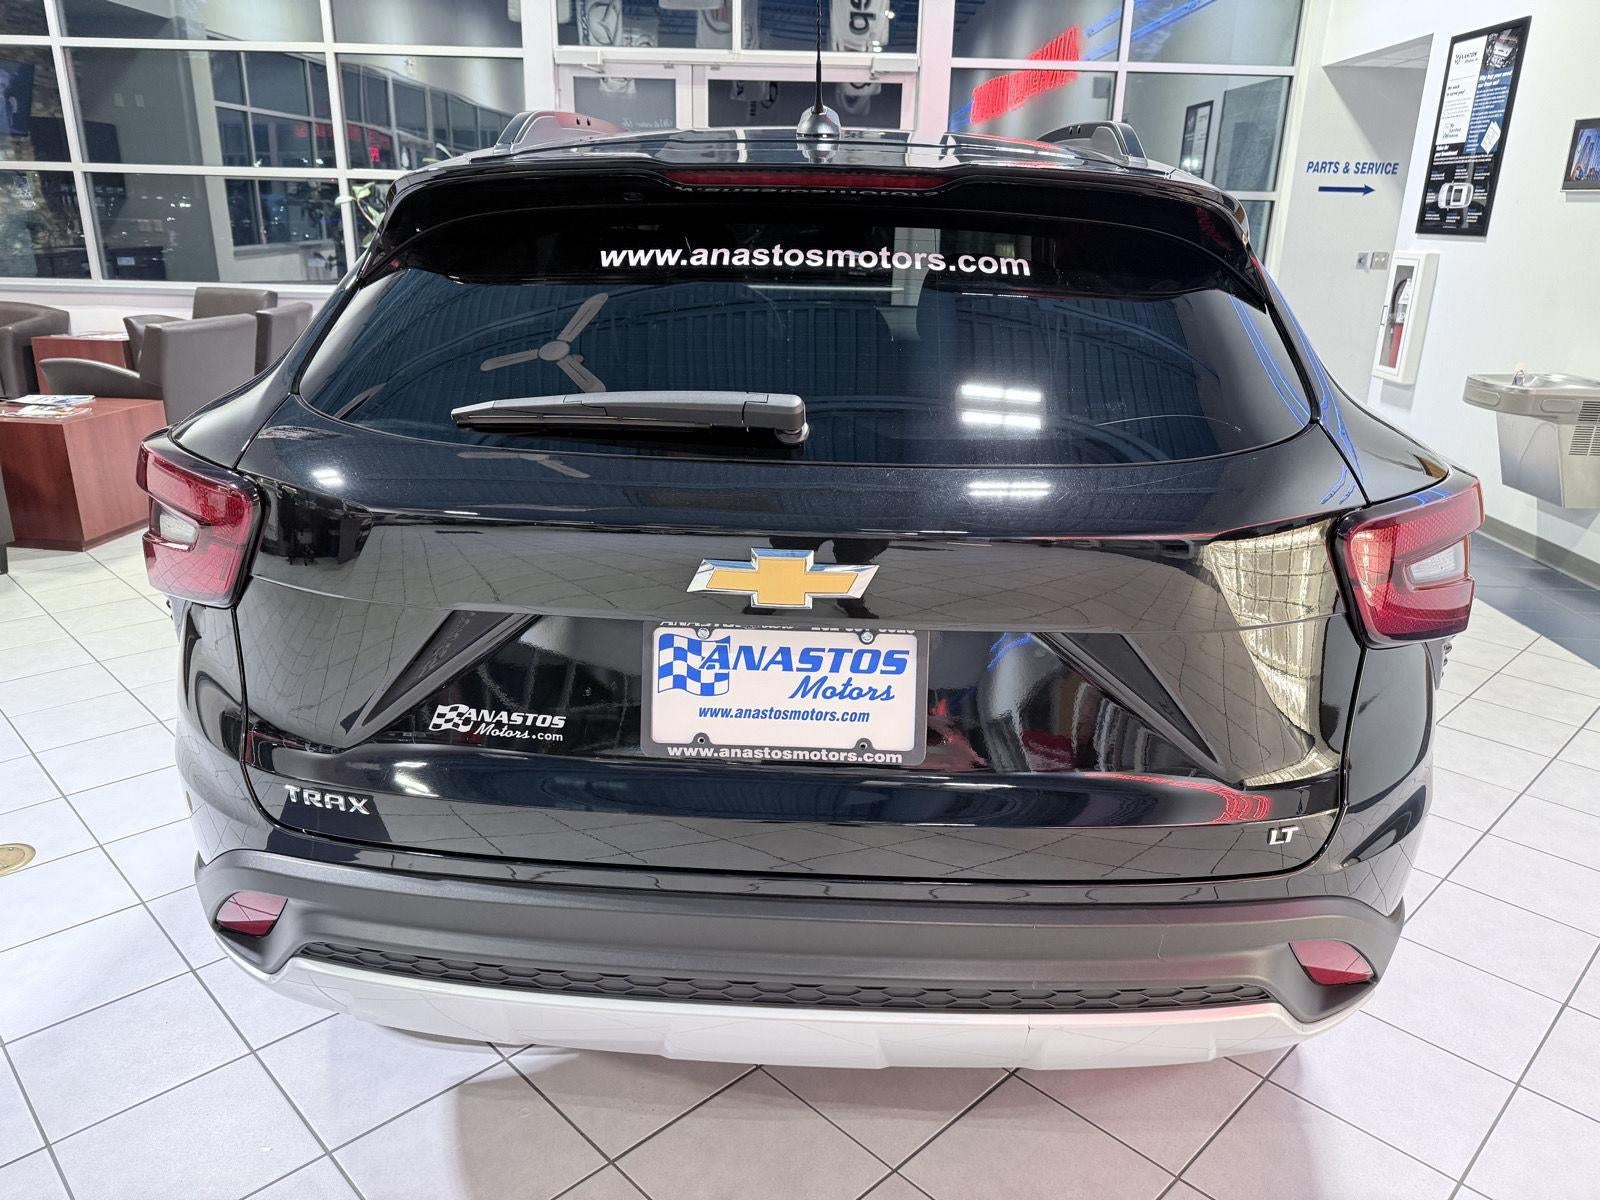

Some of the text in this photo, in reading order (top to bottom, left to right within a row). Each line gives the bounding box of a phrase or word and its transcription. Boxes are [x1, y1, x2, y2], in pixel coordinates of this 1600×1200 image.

[1306, 161, 1400, 175] PARTS & SERVICE
[599, 244, 1031, 277] www.anastosmotors.com
[699, 643, 910, 675] ANASTOS
[788, 674, 896, 702] Motors
[460, 708, 567, 729] ANASTOS
[698, 705, 871, 723] www.anastosmotors.com
[473, 722, 564, 742] Motors.com
[667, 746, 903, 764] www.anastosmotors.com
[283, 784, 371, 815] TRAX
[1269, 826, 1299, 846] LT
